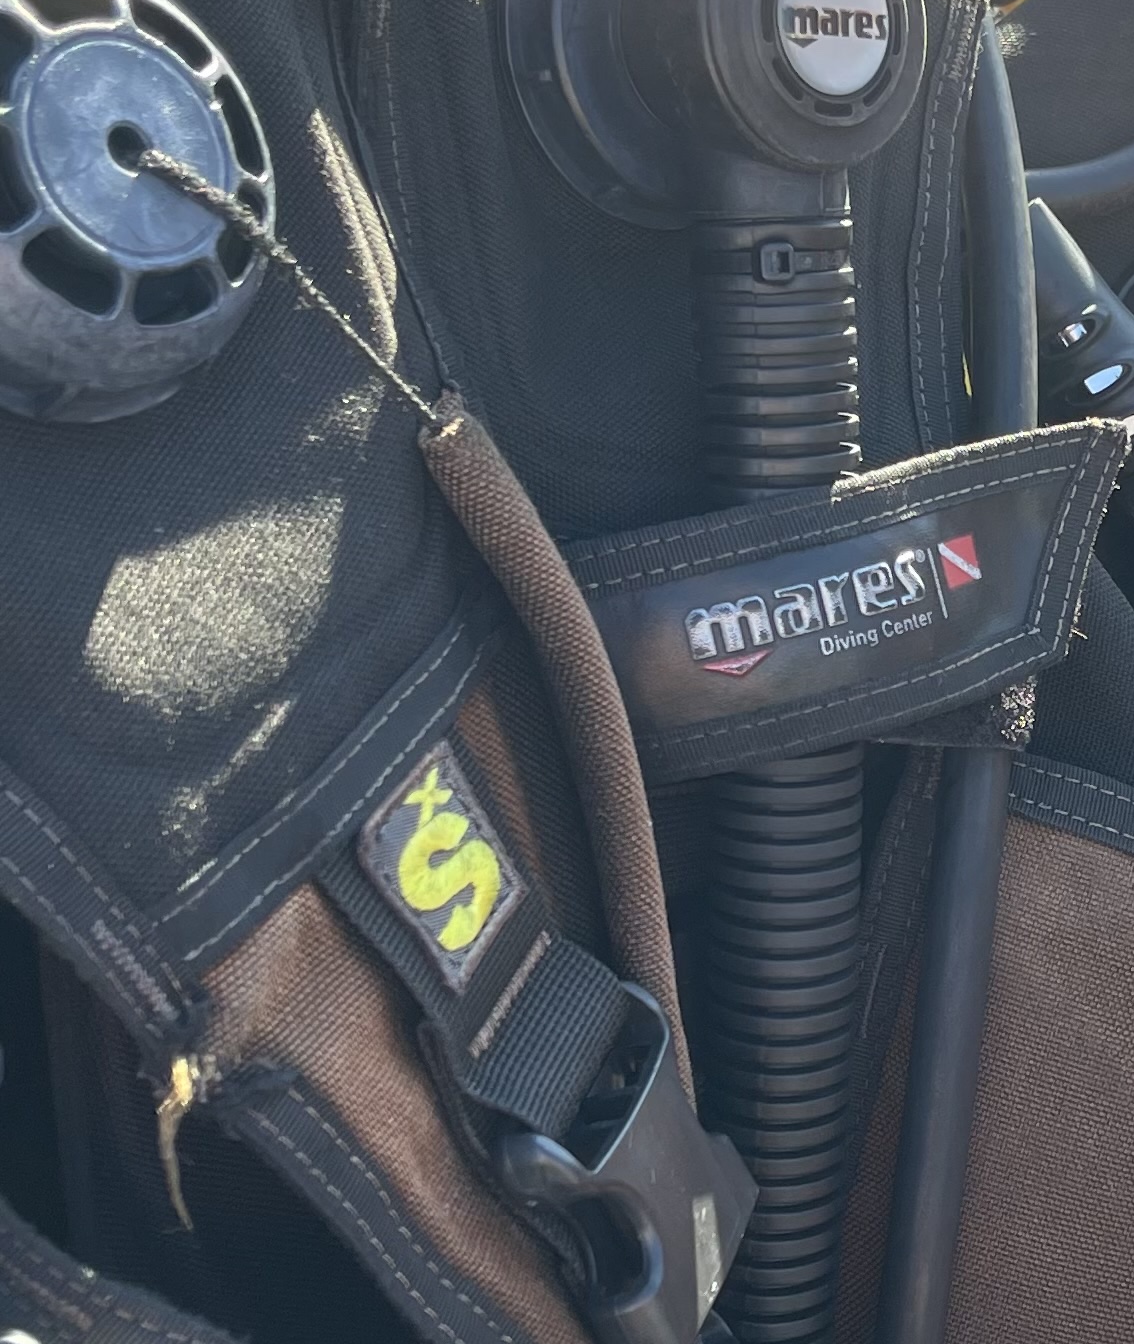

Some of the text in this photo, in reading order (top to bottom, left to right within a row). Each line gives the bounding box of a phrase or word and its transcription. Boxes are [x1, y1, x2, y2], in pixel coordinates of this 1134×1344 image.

[781, 6, 887, 41] mares
[819, 609, 934, 657] Diving Center
